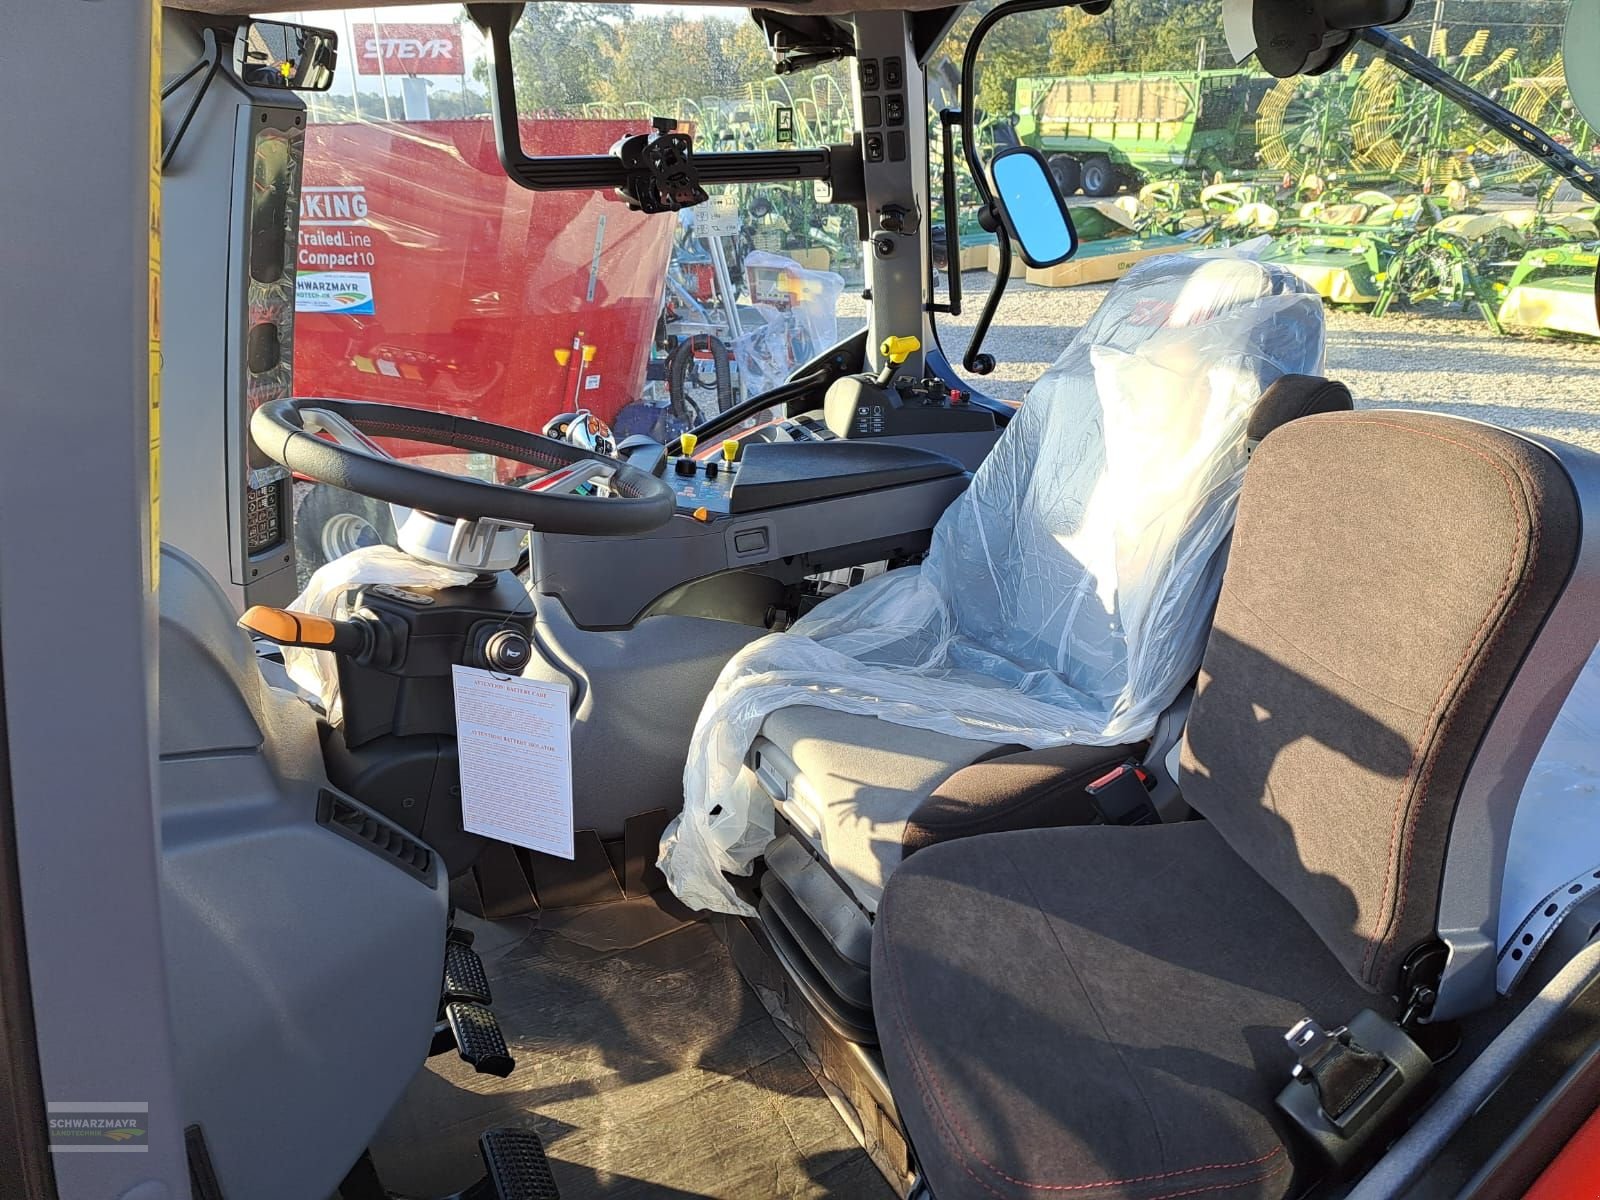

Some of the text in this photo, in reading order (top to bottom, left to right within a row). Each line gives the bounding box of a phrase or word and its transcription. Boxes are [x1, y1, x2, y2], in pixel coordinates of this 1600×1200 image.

[362, 38, 453, 59] STEYR
[1054, 101, 1119, 118] KRONE
[301, 194, 368, 218] KING
[296, 279, 359, 292] HWARZMAYR
